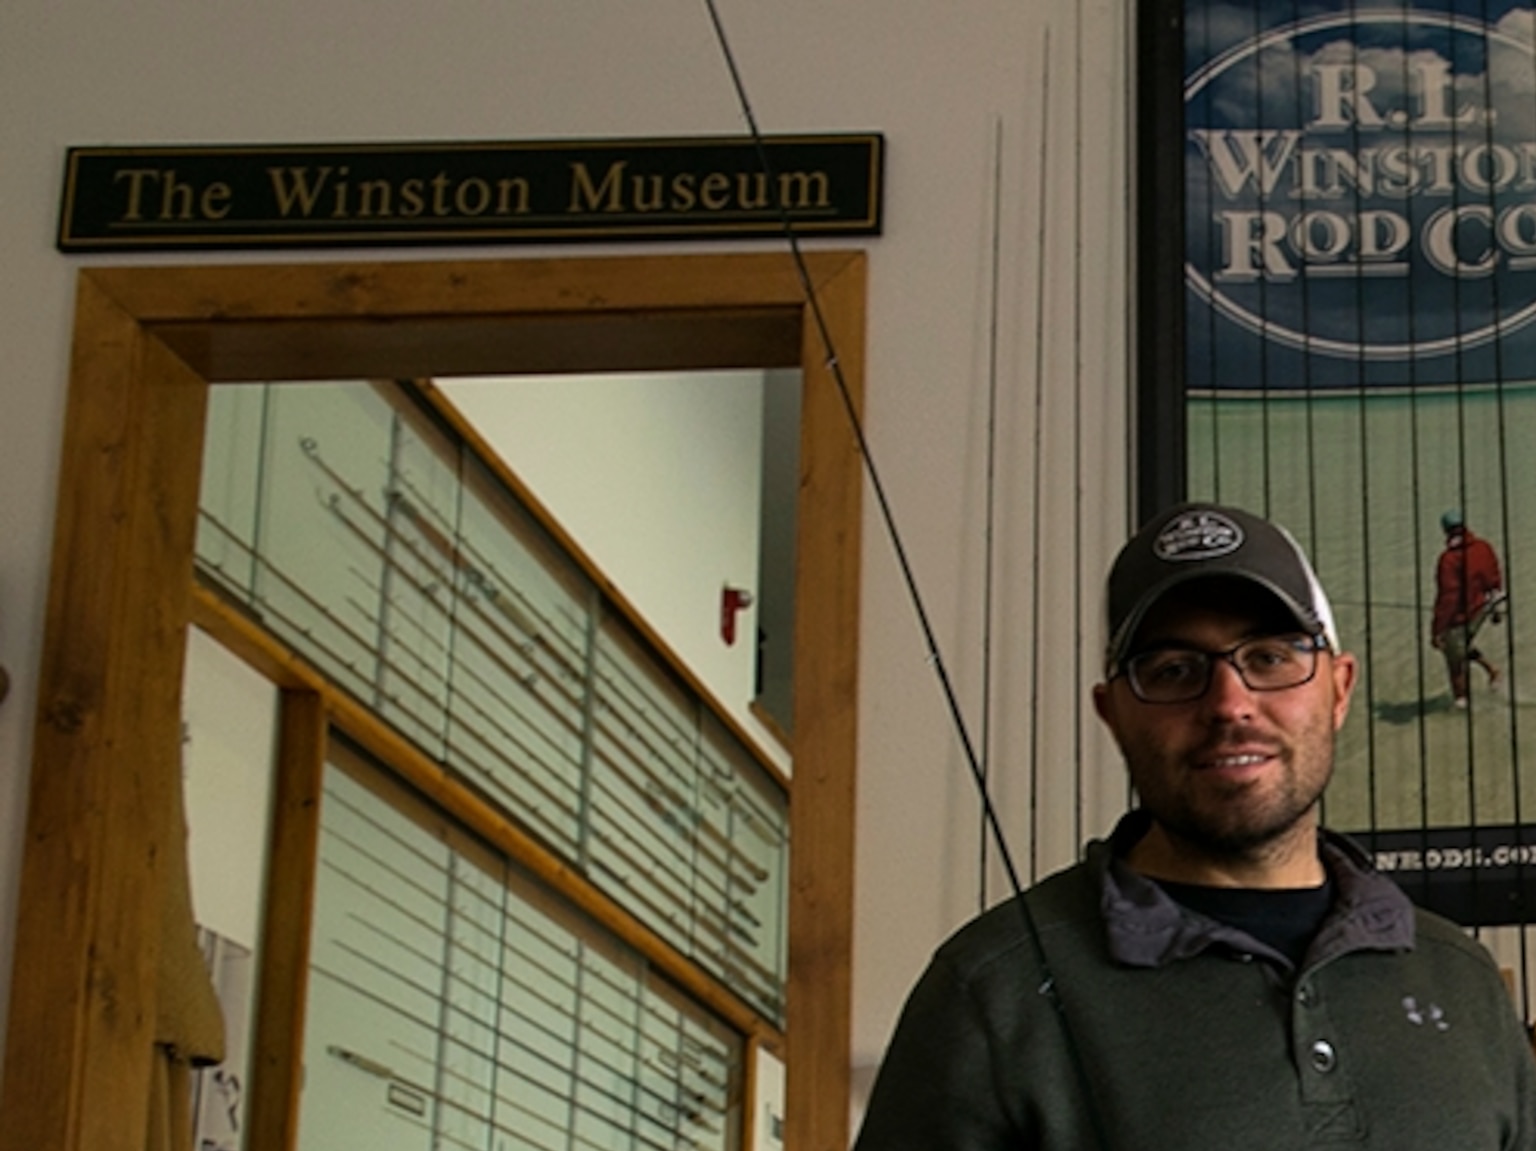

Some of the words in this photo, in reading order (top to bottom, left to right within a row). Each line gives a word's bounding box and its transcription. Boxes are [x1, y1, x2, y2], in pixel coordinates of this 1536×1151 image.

[1307, 59, 1498, 132] R.L.
[114, 166, 231, 220] The
[267, 164, 531, 218] Winston
[565, 160, 832, 214] Museum
